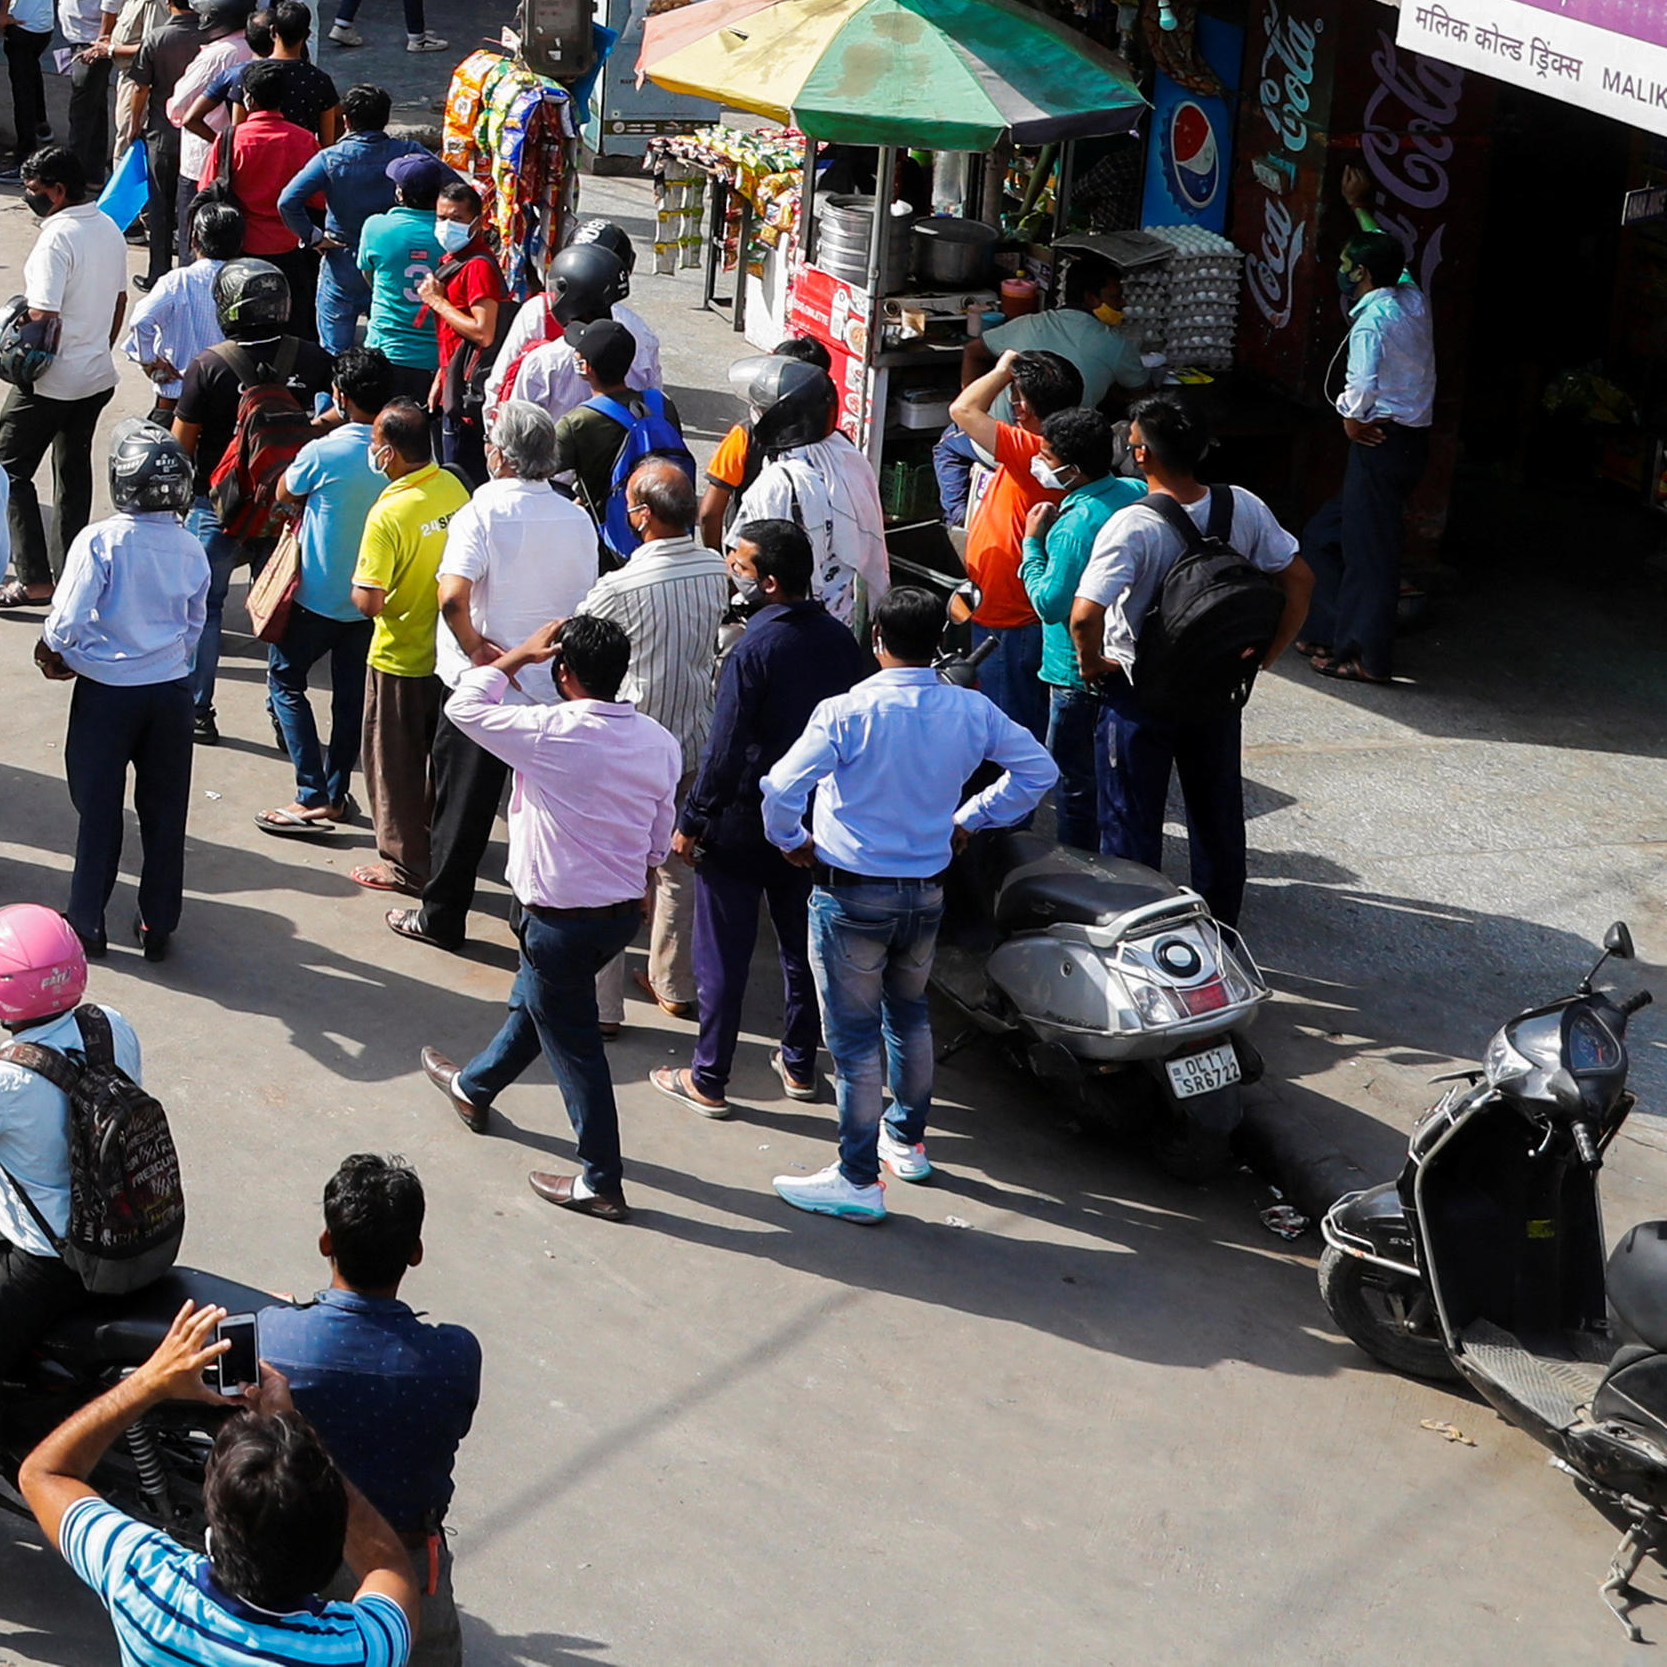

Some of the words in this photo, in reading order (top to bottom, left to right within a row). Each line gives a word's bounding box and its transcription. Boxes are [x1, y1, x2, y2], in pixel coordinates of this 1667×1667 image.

[1416, 4, 1470, 43] मलिक
[1475, 23, 1524, 62] कोल्ड
[1529, 37, 1583, 82] ड्रिंक्स
[1182, 1062, 1240, 1093] SR6722
